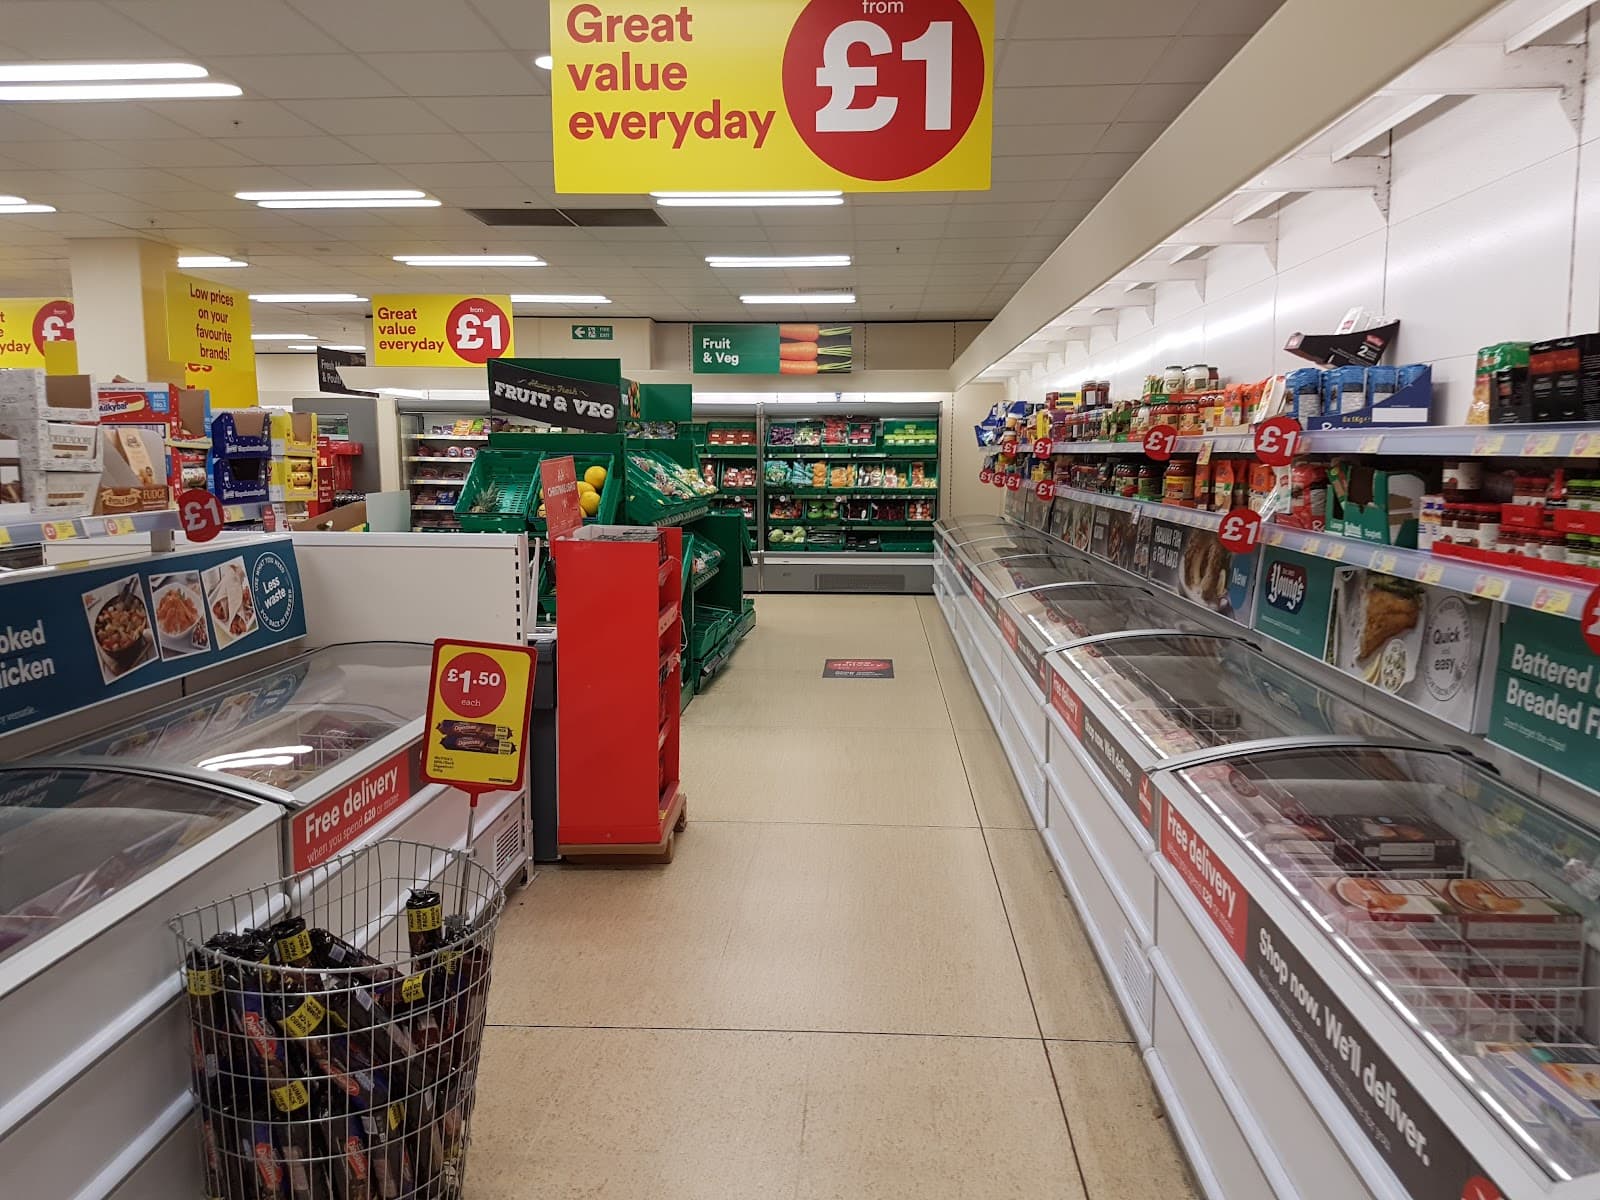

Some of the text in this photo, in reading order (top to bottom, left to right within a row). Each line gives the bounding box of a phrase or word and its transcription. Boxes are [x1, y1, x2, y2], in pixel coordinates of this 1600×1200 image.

[862, 0, 904, 14] from
[567, 4, 692, 42] Great
[567, 52, 687, 91] value
[816, 20, 953, 133] £1
[569, 99, 776, 149] everyday
[189, 283, 234, 307] Low prices
[198, 308, 228, 324] on your
[377, 307, 417, 320] Great
[196, 324, 232, 343] favourite
[378, 322, 416, 335] value
[456, 313, 502, 349] £1
[200, 343, 230, 360] brands!
[379, 338, 445, 353] everyday
[703, 338, 731, 349] Fruit
[703, 352, 739, 366] & Veg
[494, 381, 551, 408] FRUIT
[553, 397, 568, 412] &
[573, 398, 615, 419] VEG
[1003, 443, 1017, 454] £1
[1035, 441, 1052, 455] £1
[1145, 431, 1175, 453] £1
[1260, 426, 1296, 456] £1
[981, 472, 991, 481] £1
[995, 475, 1006, 485] £1
[1007, 476, 1021, 488] £1
[1037, 483, 1054, 496] £1
[184, 498, 221, 532] £1
[1221, 517, 1259, 544] £1
[263, 577, 281, 594] Less
[1232, 567, 1248, 587] New
[1268, 563, 1304, 610] Young's
[264, 587, 286, 609] waste
[0, 619, 46, 653] oked
[1433, 626, 1460, 645] Quick
[0, 658, 56, 689] icken
[1434, 658, 1455, 674] easy
[1511, 643, 1594, 694] Battered
[447, 668, 500, 693] £1.50
[461, 699, 480, 707] each
[1506, 677, 1583, 730] Breaded
[305, 767, 397, 844] Free delivery
[307, 843, 328, 864] when
[328, 833, 342, 852] you
[343, 816, 363, 840] spend
[363, 806, 376, 824] £20
[1167, 802, 1236, 918] Free delivery
[1259, 927, 1430, 1167] Shop now. We'll deliver.
